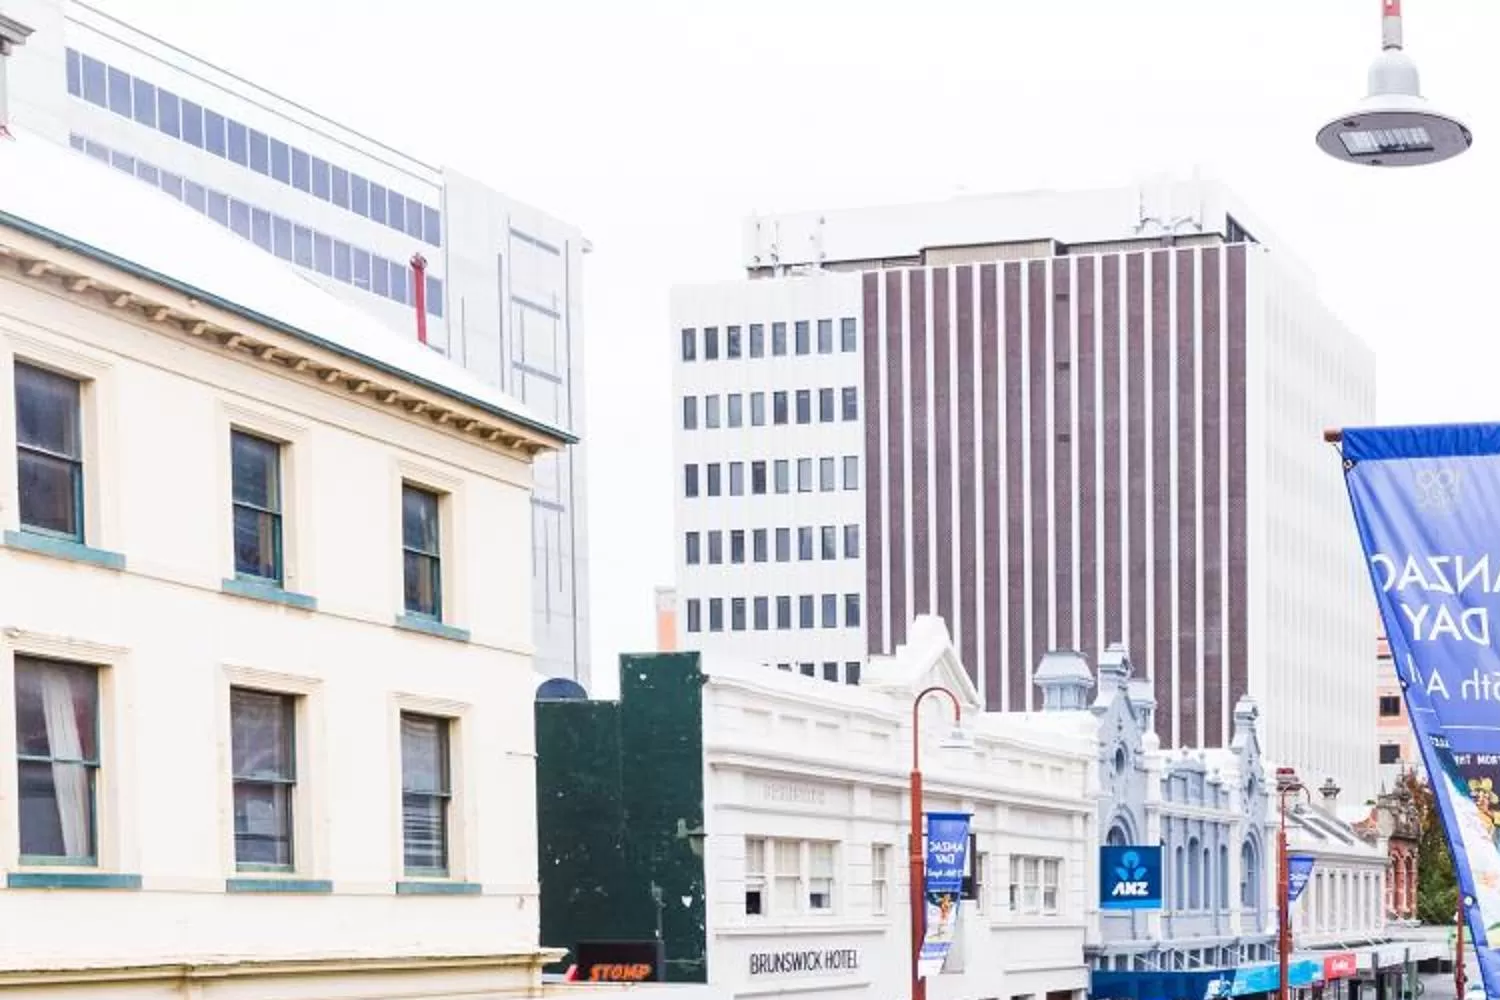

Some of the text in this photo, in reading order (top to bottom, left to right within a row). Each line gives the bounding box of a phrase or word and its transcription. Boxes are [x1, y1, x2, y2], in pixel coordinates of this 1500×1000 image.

[1111, 881, 1150, 897] ANZ
[589, 963, 651, 982] STOMP
[750, 950, 859, 976] BRUNSWICK HOTEL
